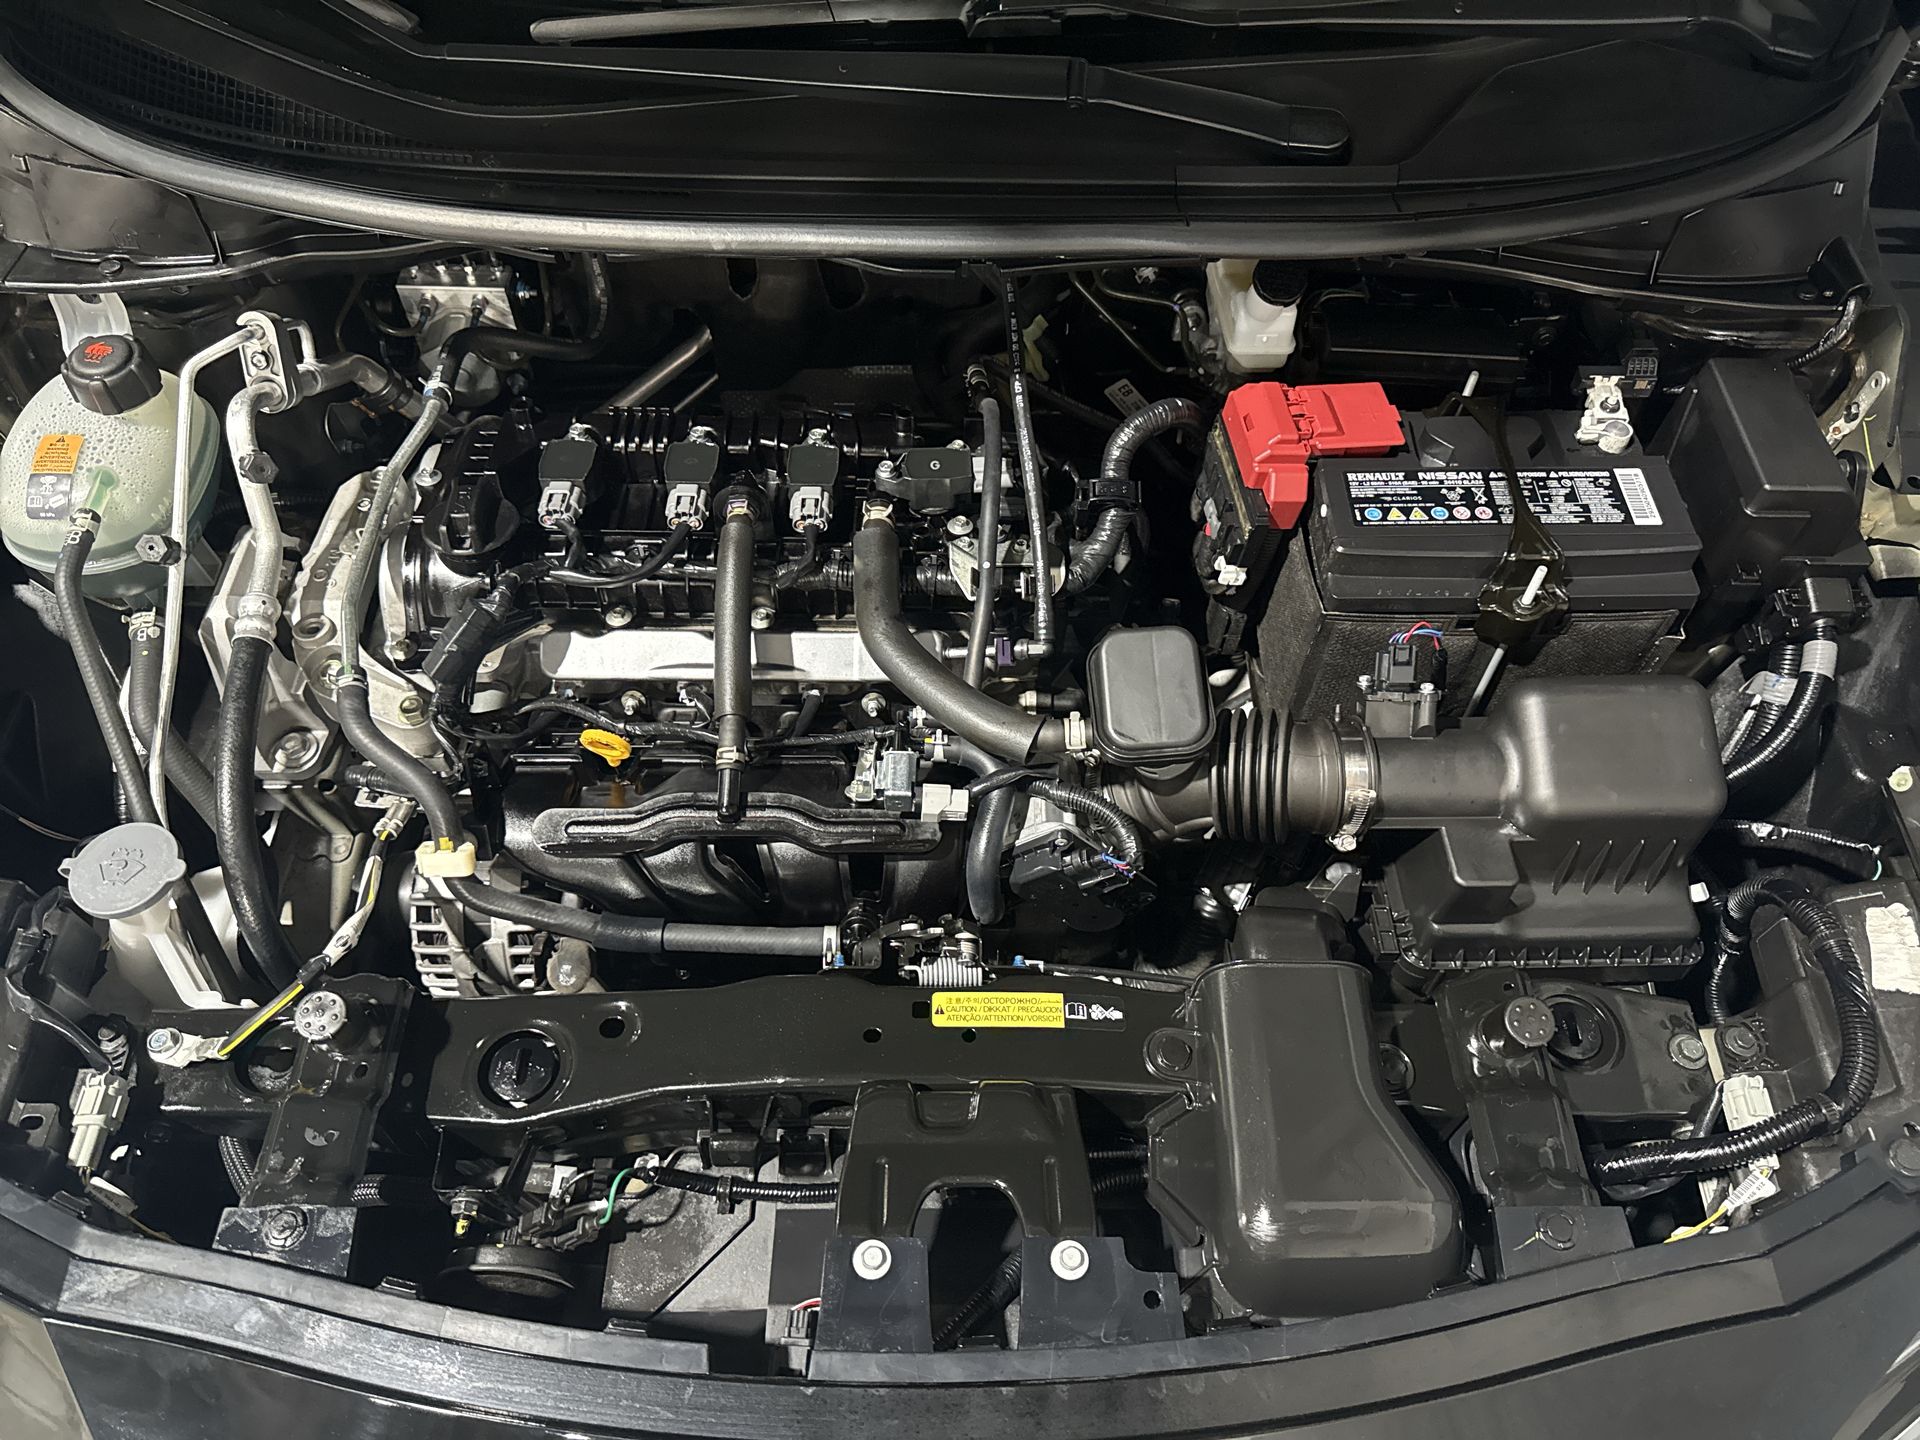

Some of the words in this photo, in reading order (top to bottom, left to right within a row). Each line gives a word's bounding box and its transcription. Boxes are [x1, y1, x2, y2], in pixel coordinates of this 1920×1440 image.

[1118, 384, 1133, 397] EB
[930, 460, 941, 470] G
[1346, 472, 1405, 481] RENAULT
[1418, 472, 1482, 480] NISSAN
